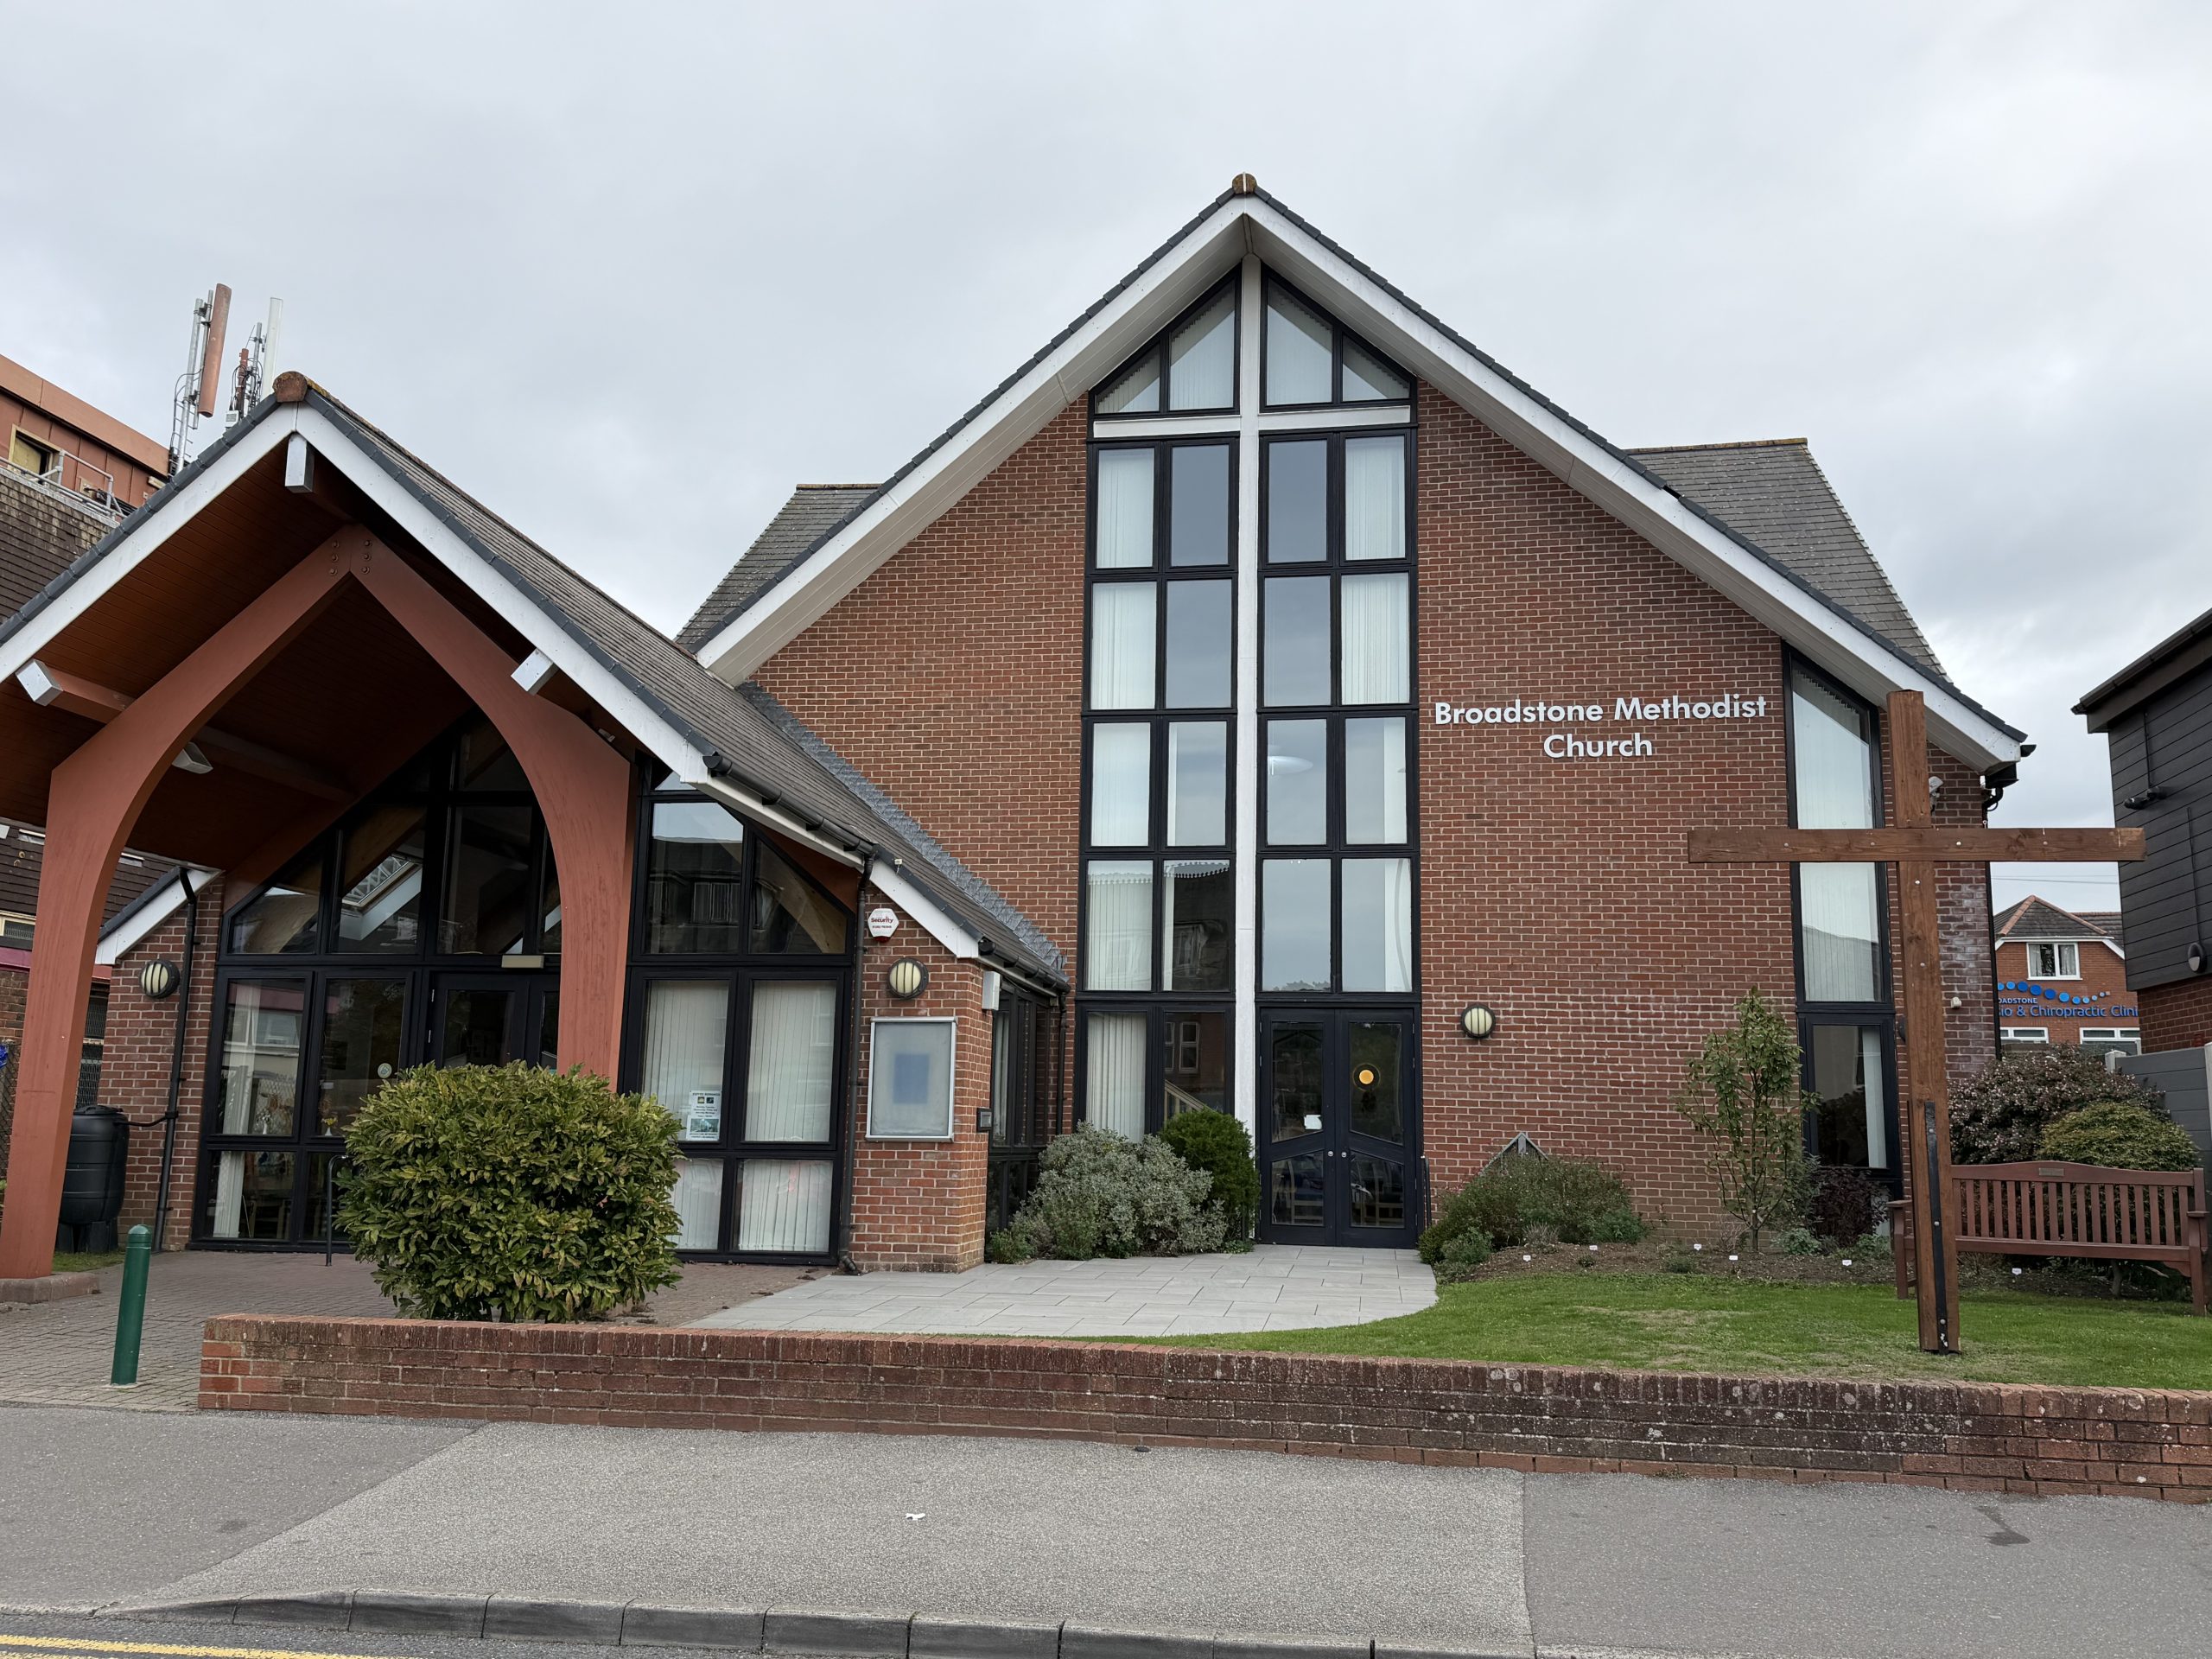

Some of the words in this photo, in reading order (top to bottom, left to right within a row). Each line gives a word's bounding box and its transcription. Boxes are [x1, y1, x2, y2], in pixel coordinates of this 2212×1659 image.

[1434, 698, 1605, 725] Broadstone
[1614, 693, 1767, 721] Methodist
[1543, 732, 1653, 758] Church
[1999, 1005, 2013, 1017] io
[2017, 1005, 2026, 1017] &
[2031, 1005, 2107, 1018] Chiropractic
